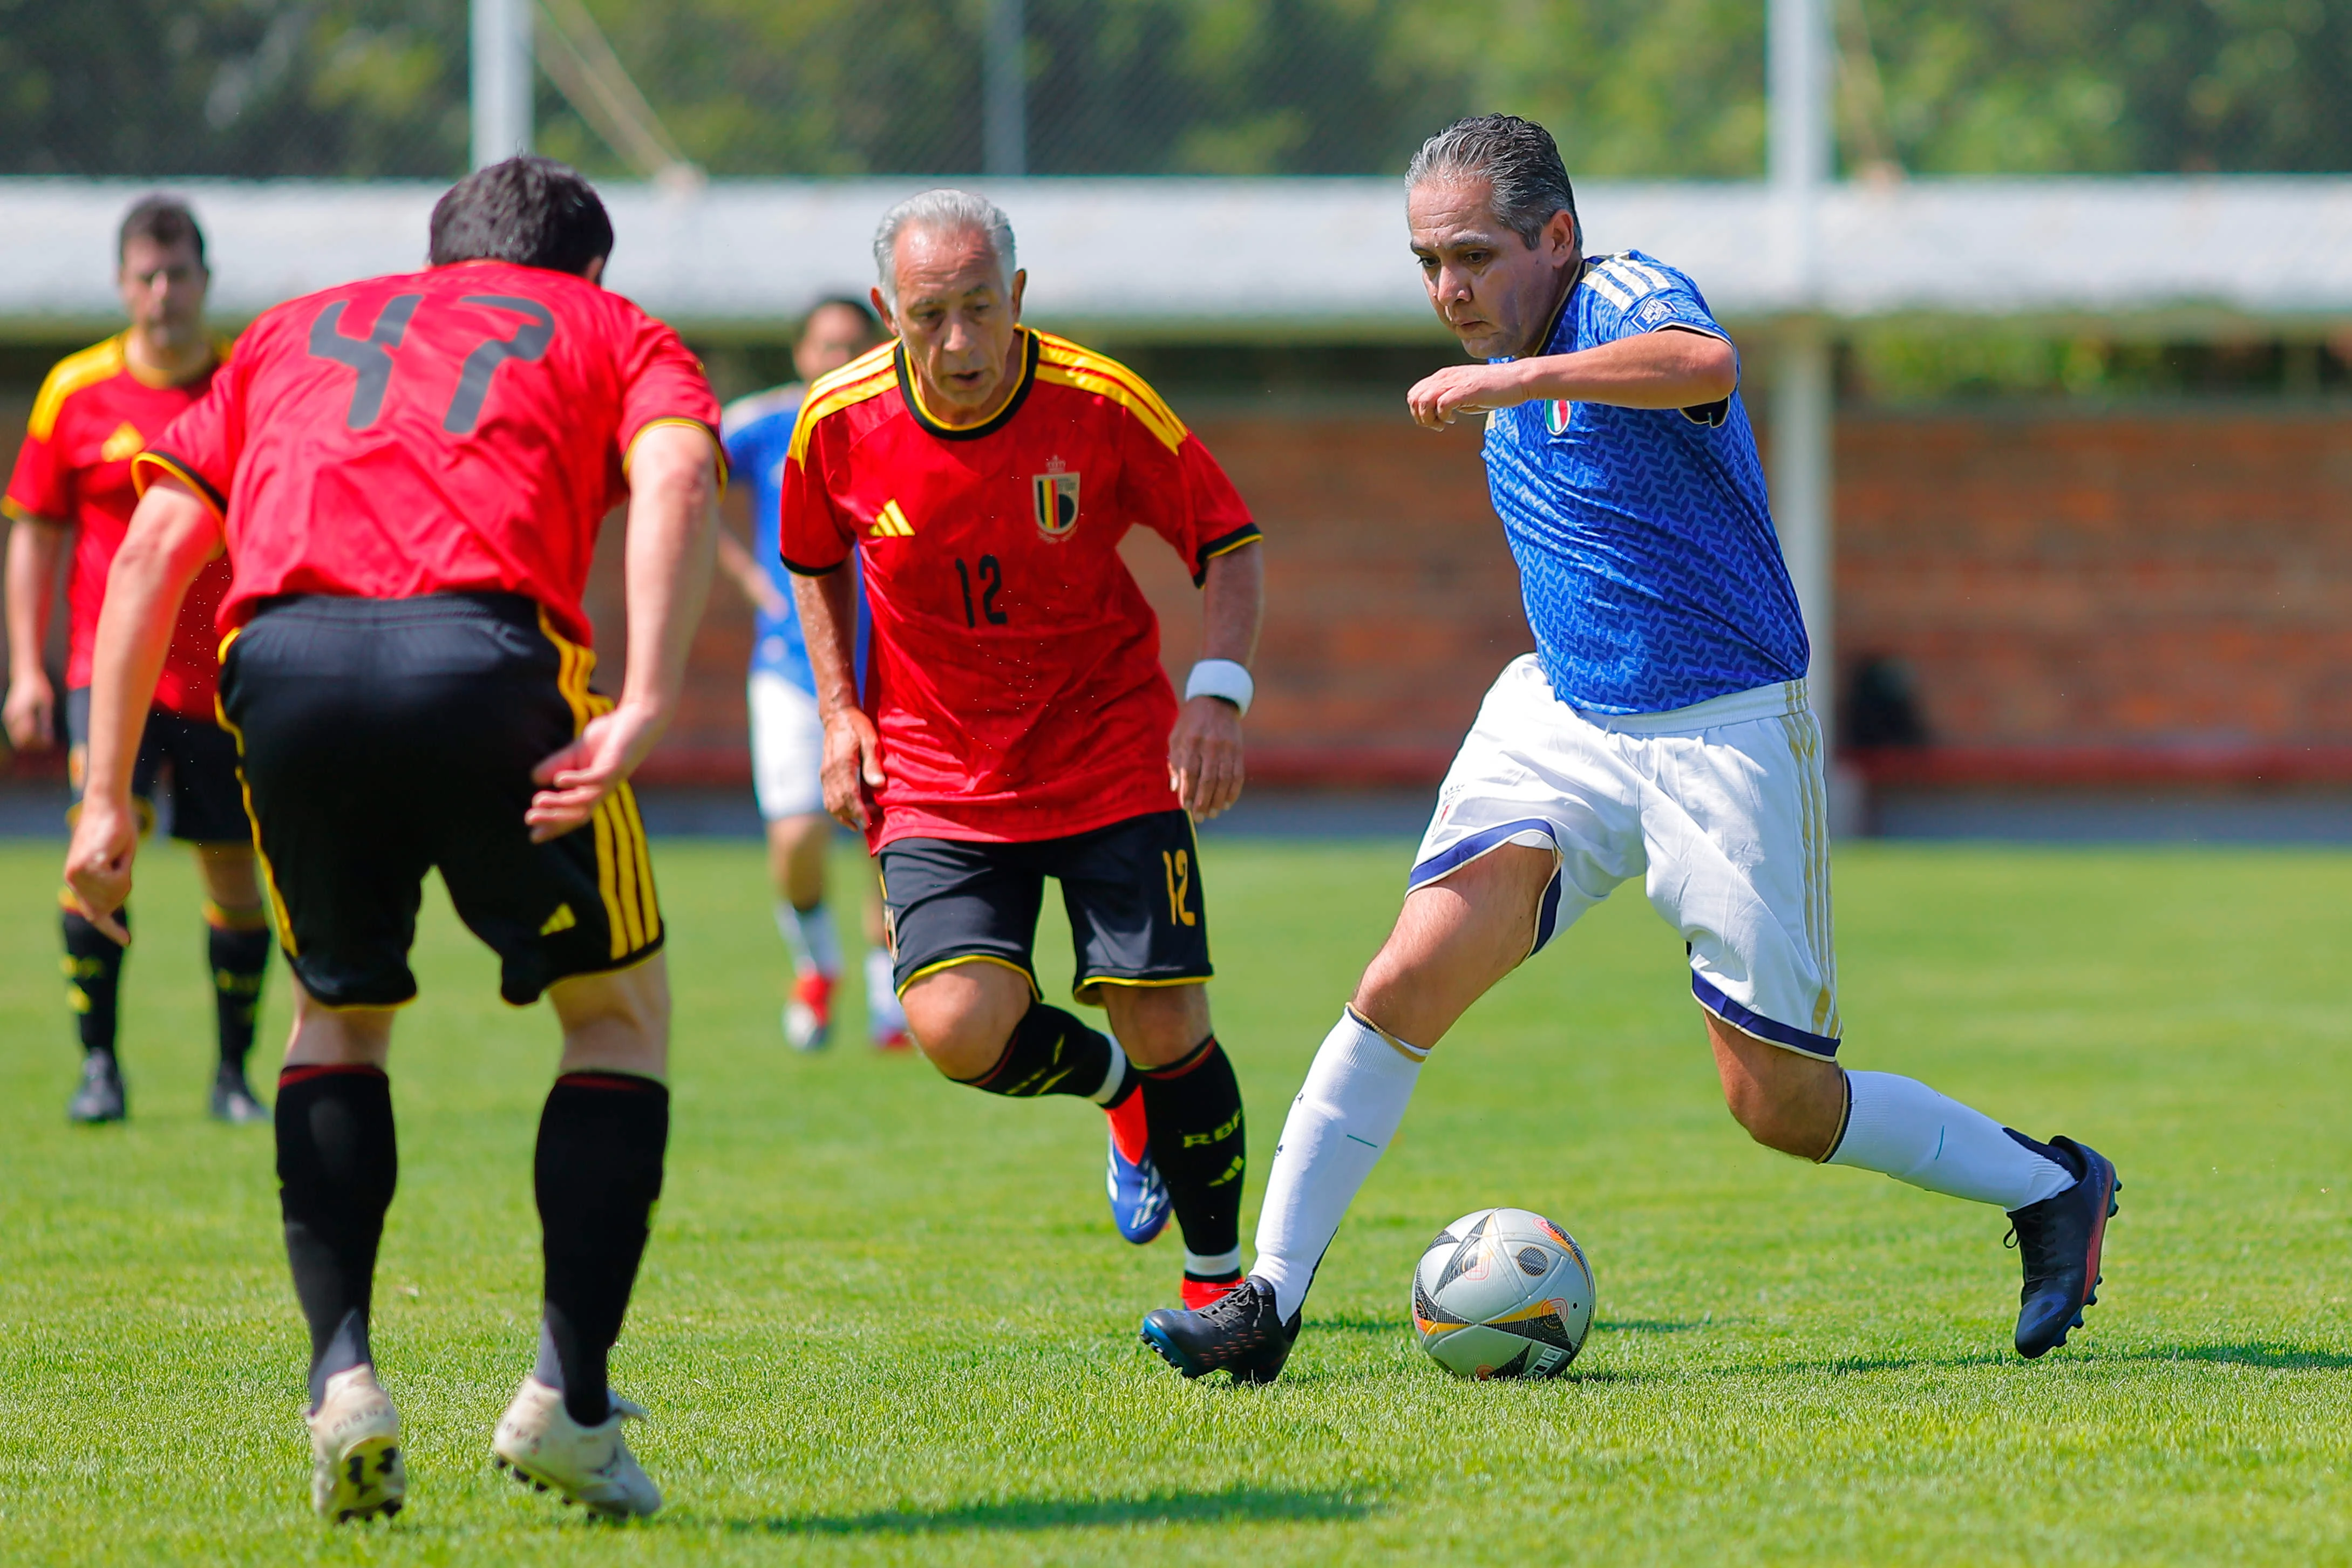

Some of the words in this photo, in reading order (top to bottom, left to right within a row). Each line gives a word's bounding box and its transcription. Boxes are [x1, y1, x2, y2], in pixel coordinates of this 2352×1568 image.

[308, 294, 555, 434] 47
[955, 554, 1008, 628] 12
[1162, 849, 1196, 927] 12
